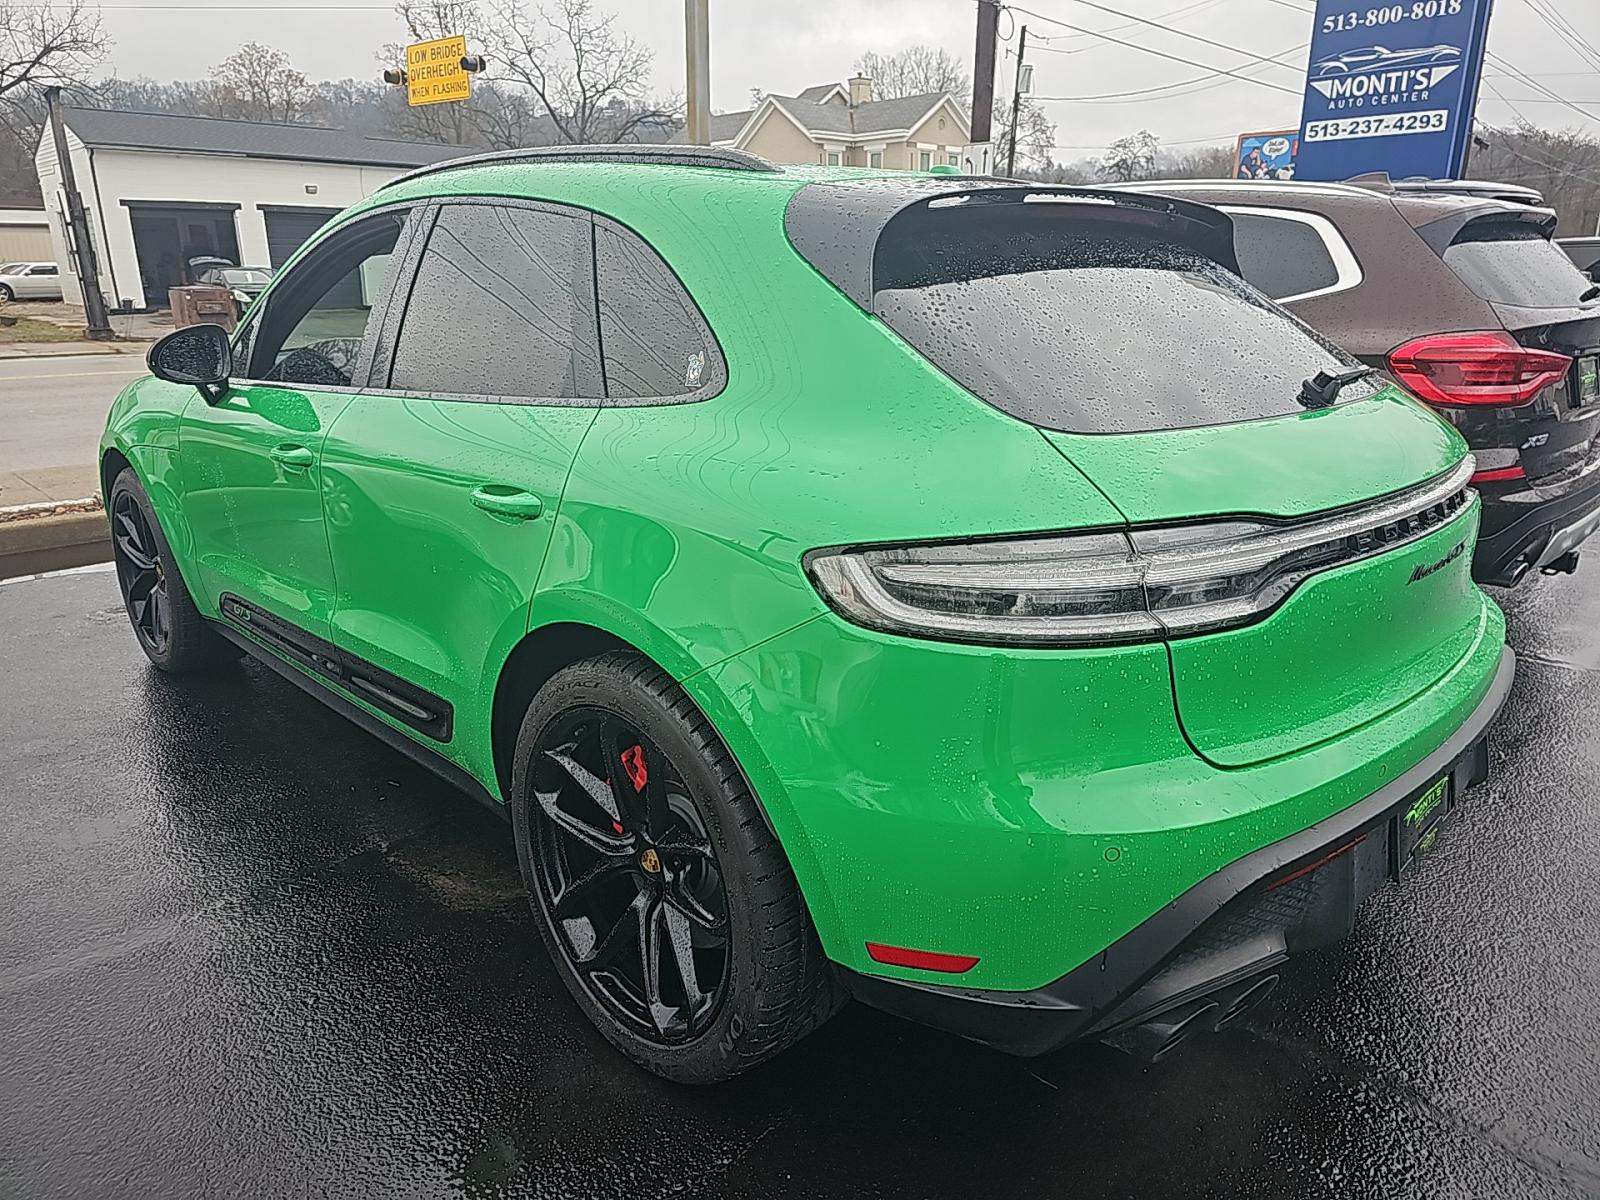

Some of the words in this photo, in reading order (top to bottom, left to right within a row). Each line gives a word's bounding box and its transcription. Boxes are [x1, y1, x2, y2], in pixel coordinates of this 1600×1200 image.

[1321, 0, 1462, 34] 513-800-8018
[409, 49, 427, 65] LOW
[430, 43, 463, 61] BRIDGE
[411, 86, 430, 98] WHEN
[432, 81, 468, 96] FLASHING
[1331, 68, 1430, 99] MONTI'S
[1328, 96, 1364, 110] AUTO
[1371, 90, 1430, 106] CENTER
[1307, 112, 1444, 139] 513-237-4293
[1520, 432, 1550, 450] X3
[233, 604, 251, 621] GTS
